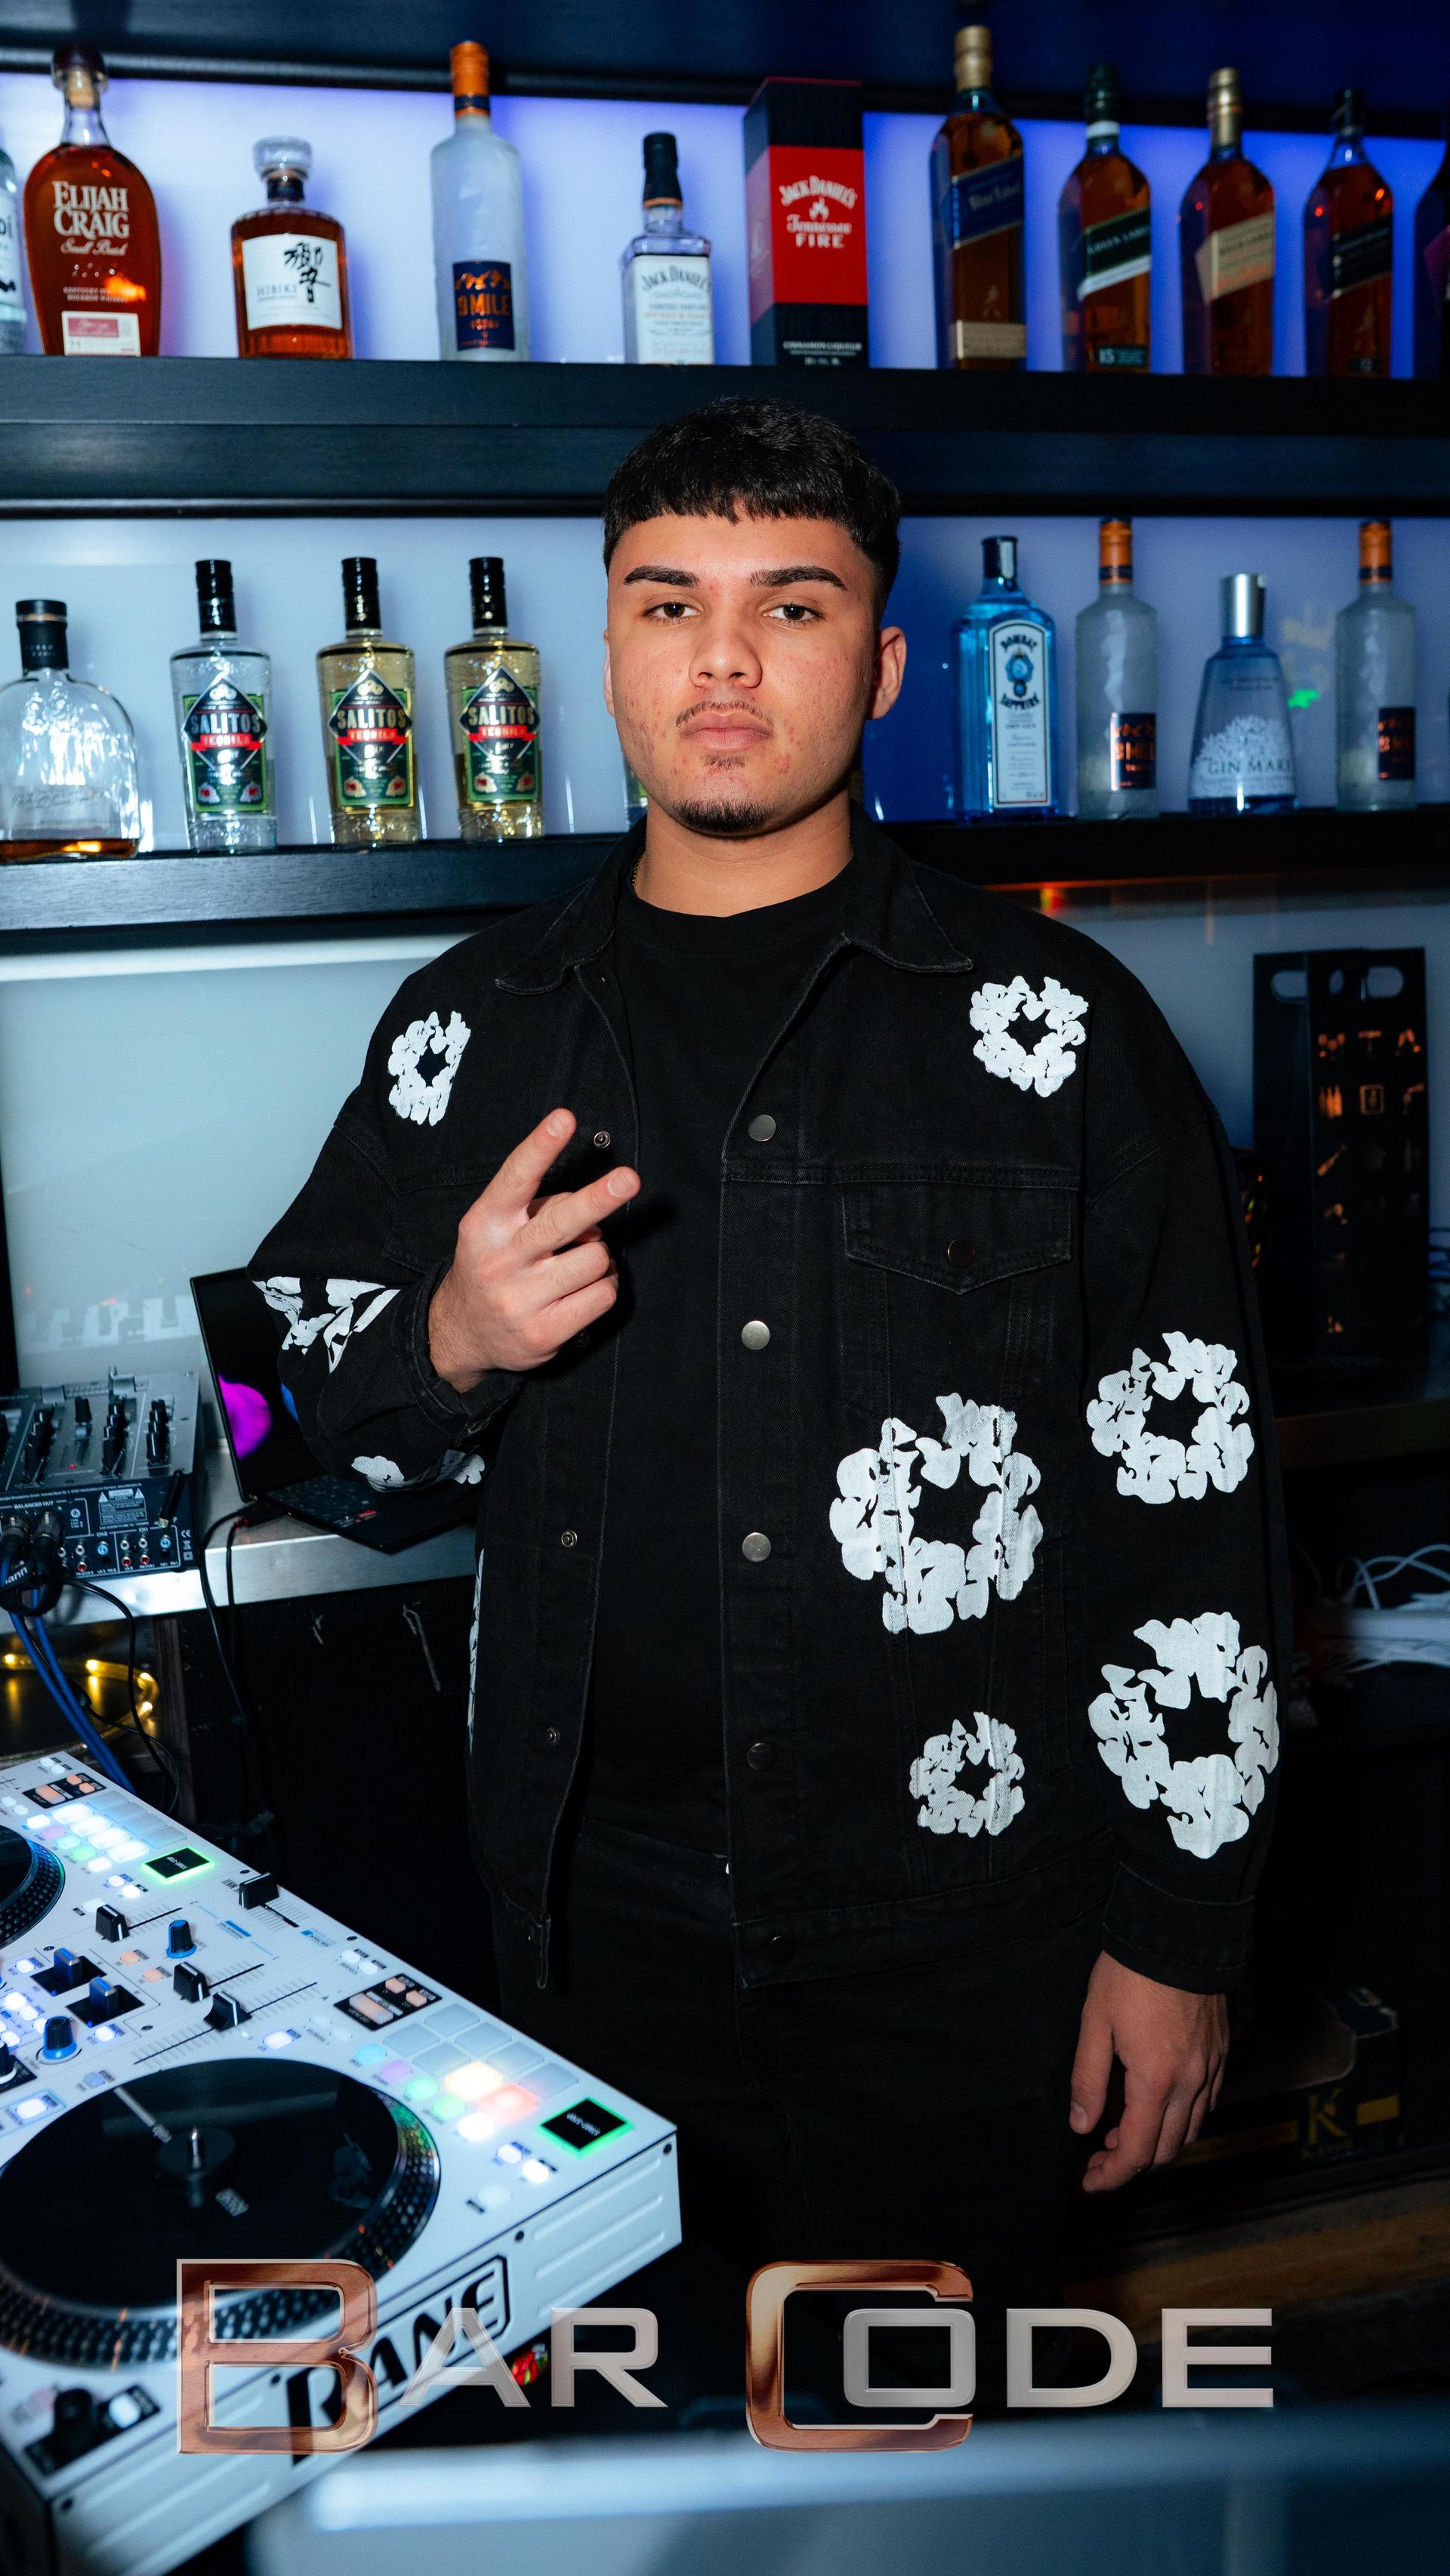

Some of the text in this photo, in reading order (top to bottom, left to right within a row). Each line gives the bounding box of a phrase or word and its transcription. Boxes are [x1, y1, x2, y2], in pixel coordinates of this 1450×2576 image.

[52, 180, 128, 213] ELIJAH
[779, 174, 858, 209] JACK DANIEL'S
[54, 208, 130, 240] CRAIG
[60, 238, 128, 256] Small Batch
[795, 233, 845, 248] FIRE
[669, 264, 711, 292] DANIEL
[470, 292, 510, 316] MILE
[1100, 347, 1116, 366] 15
[999, 634, 1038, 652] BOMBAY
[999, 693, 1041, 710] SAPPHIRE
[190, 712, 261, 734] SALITOS
[338, 707, 406, 730] SALITOS
[467, 705, 535, 726] SALITOS
[203, 735, 250, 746] TEQUILA
[350, 729, 396, 741] TEQUILA
[481, 726, 525, 737] TEQUILA
[1208, 761, 1241, 775] GIN
